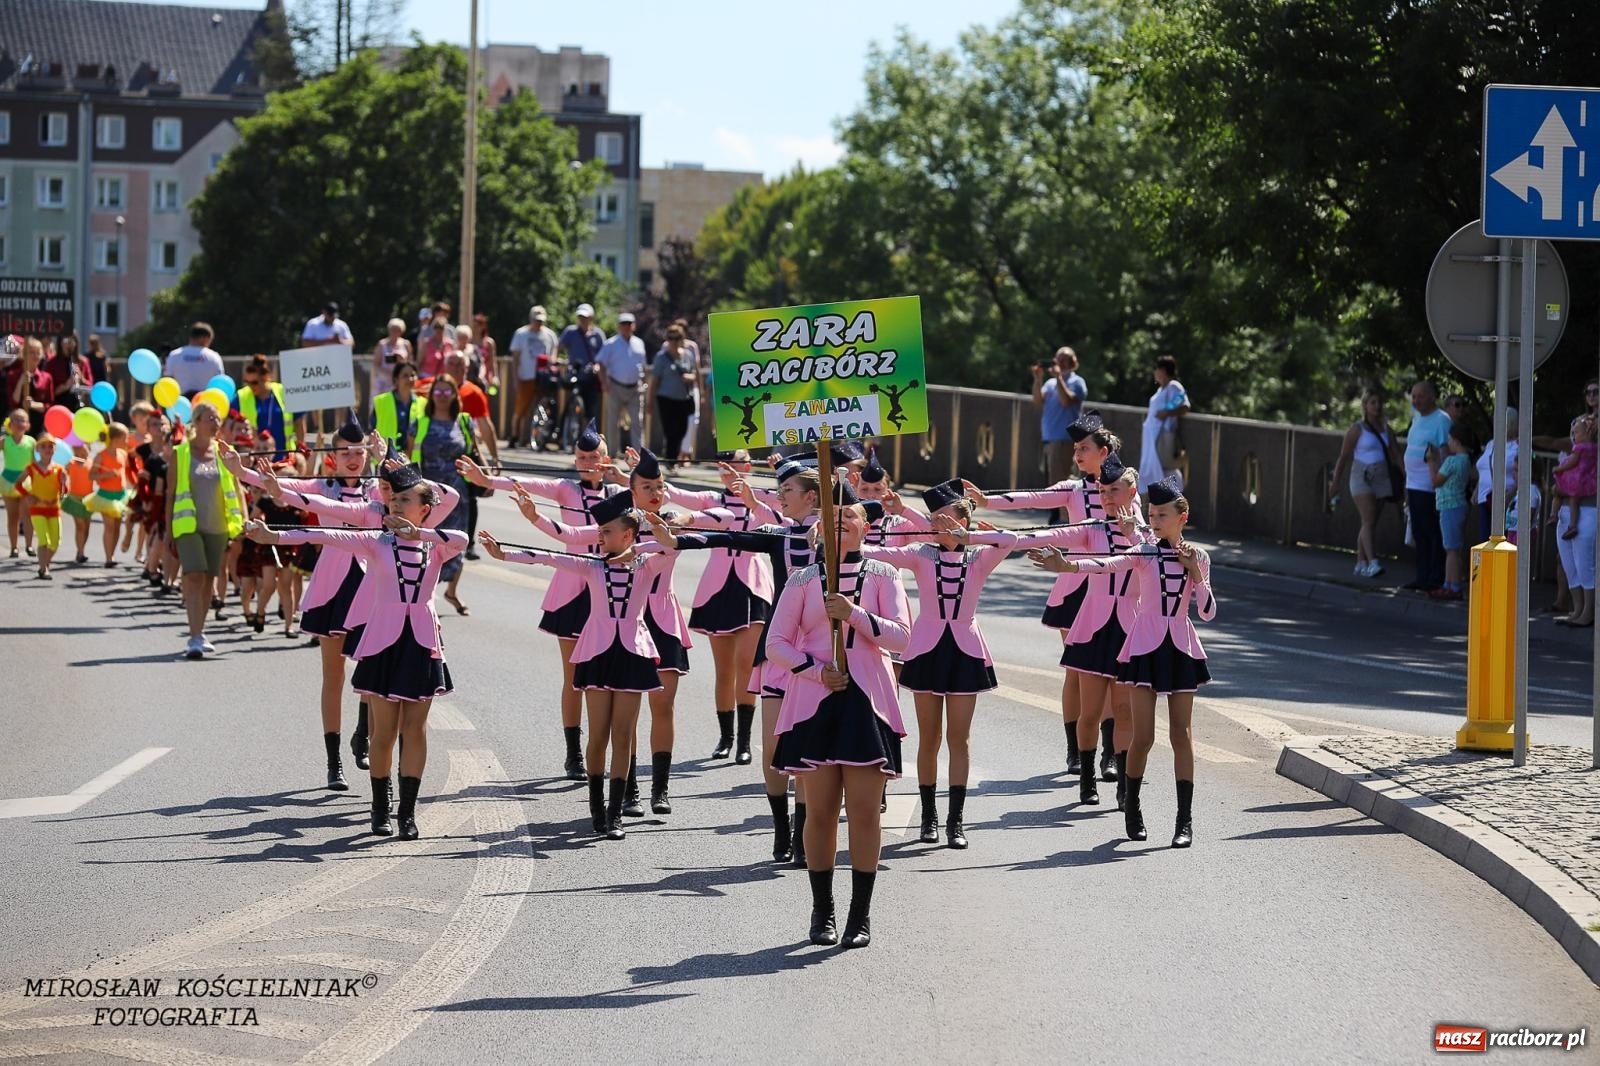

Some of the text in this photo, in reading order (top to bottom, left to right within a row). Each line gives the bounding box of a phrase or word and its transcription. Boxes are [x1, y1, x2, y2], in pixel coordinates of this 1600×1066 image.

[0, 297, 72, 312] IESTRA DĘTA
[751, 311, 876, 351] ZARA
[301, 365, 331, 379] ZARA
[738, 348, 898, 388] RACIBÓRZ
[285, 385, 311, 395] POWIAT
[784, 396, 863, 418] ZAWADA
[772, 422, 875, 445] KSIĄŻĘCA
